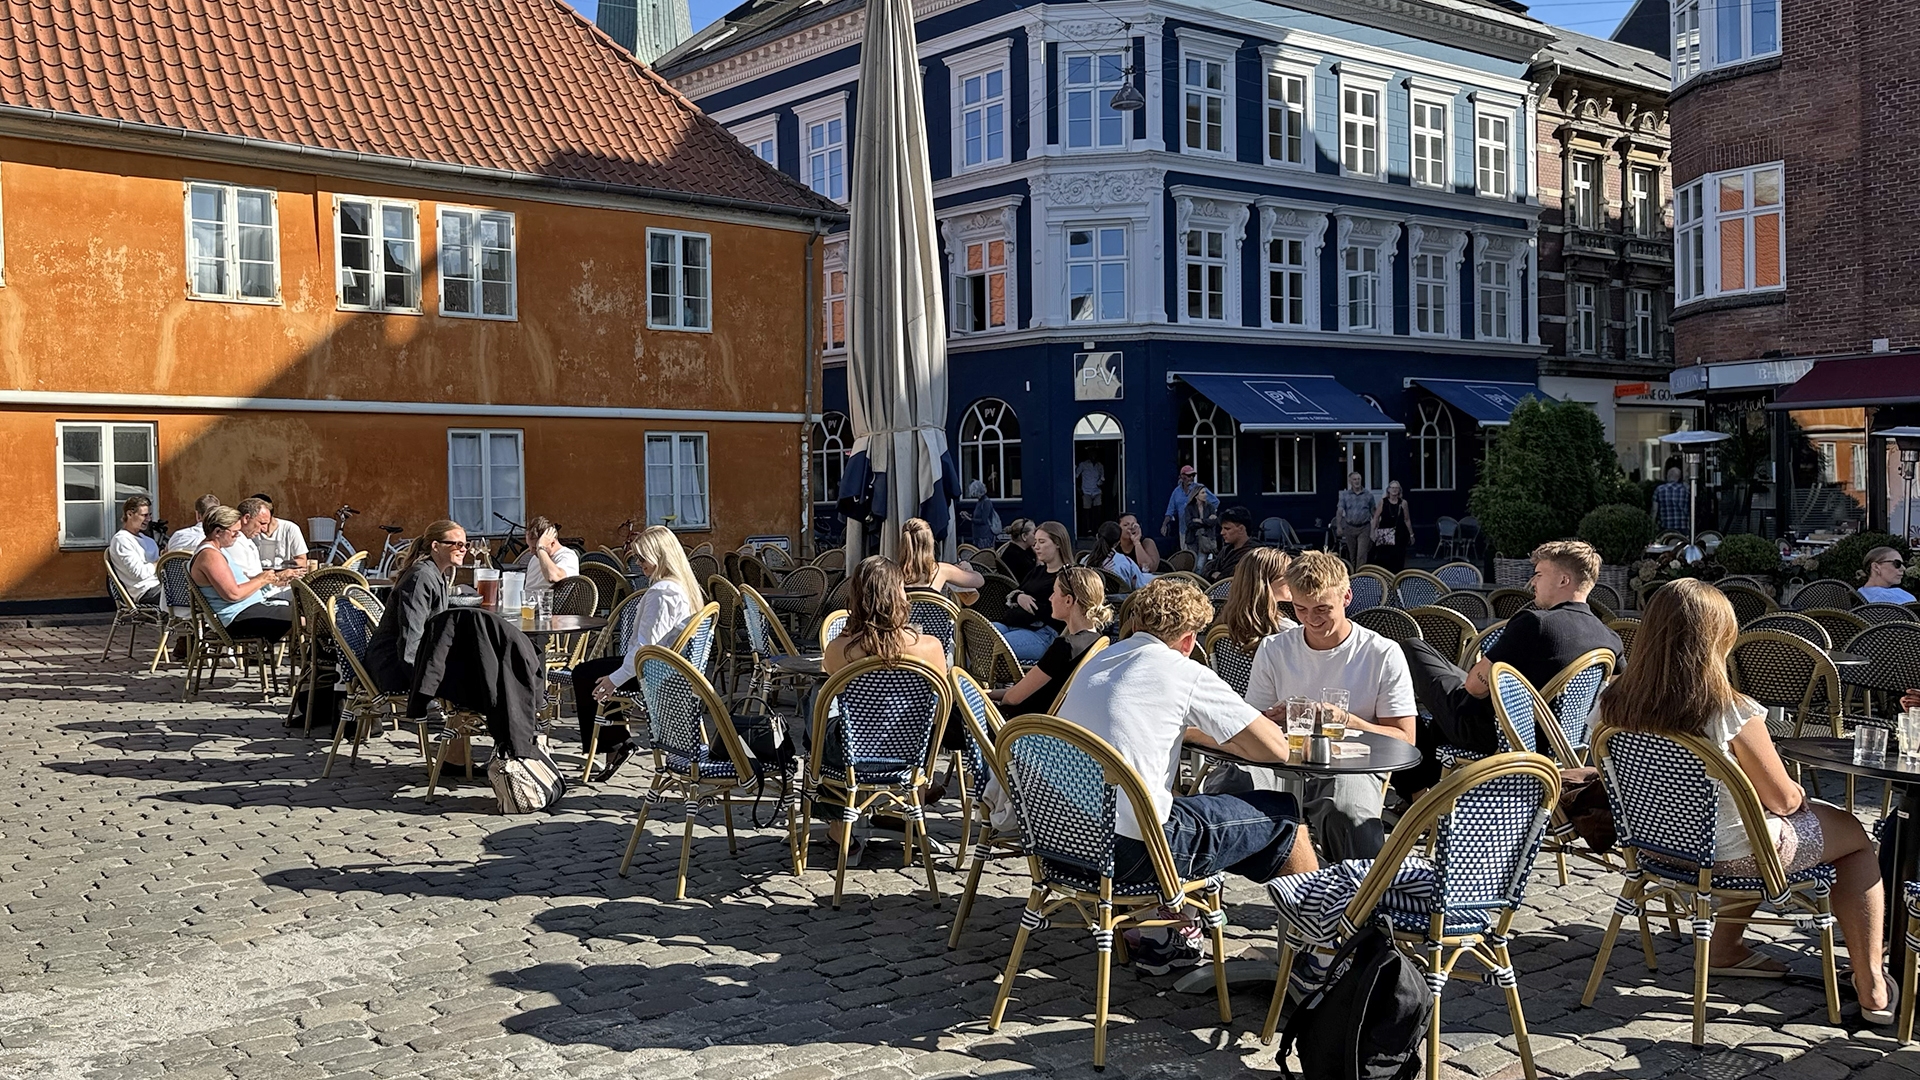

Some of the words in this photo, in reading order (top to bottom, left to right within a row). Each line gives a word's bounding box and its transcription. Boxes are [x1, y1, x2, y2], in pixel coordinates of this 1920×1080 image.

[1083, 366, 1116, 386] PV
[1264, 390, 1301, 405] PV
[984, 407, 996, 418] PV
[827, 419, 837, 429] PV
